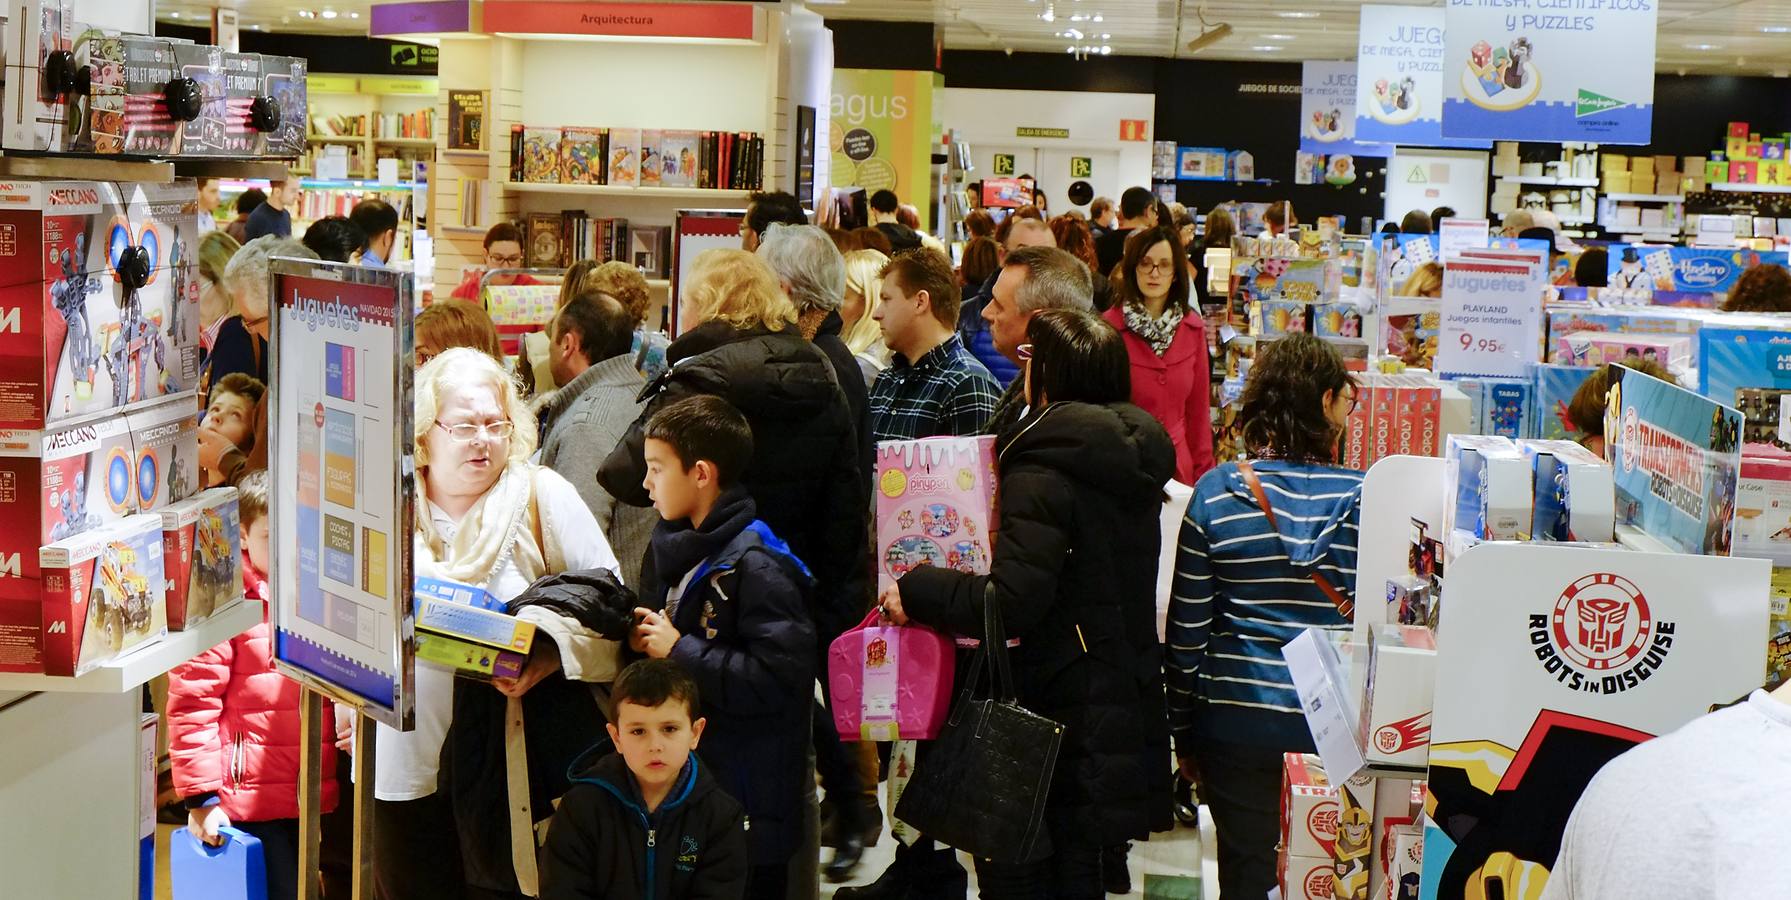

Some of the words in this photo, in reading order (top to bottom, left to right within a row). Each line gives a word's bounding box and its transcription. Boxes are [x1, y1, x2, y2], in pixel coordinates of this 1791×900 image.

[581, 13, 654, 26] Arquitectura
[1522, 16, 1594, 31] PUZZLES
[1408, 62, 1444, 72] PUZZL
[1239, 84, 1267, 92] JUEGOS
[1279, 85, 1301, 94] SOCIE
[831, 93, 907, 125] agus
[48, 189, 98, 205] MECCANO
[142, 204, 181, 216] MECCANOID
[1680, 258, 1726, 276] Hasbro
[1447, 274, 1528, 292] Juguetes
[291, 288, 360, 333] Juguetes
[360, 304, 382, 316] NAVIDAD
[1463, 304, 1508, 314] PLAYLAND
[1448, 314, 1480, 324] Juegos
[1482, 315, 1522, 325] infantiles
[1498, 390, 1520, 398] TABAS
[47, 425, 97, 450] MECCANO
[140, 423, 179, 442] MECCANOID
[1351, 417, 1363, 470] ONOPOLY
[1639, 423, 1704, 495] TRANSFORMERS
[1651, 471, 1673, 503] ROBOTS
[1529, 614, 1584, 691] ROBOTS
[1584, 681, 1599, 693] IN
[1602, 621, 1675, 694] DISGUISE
